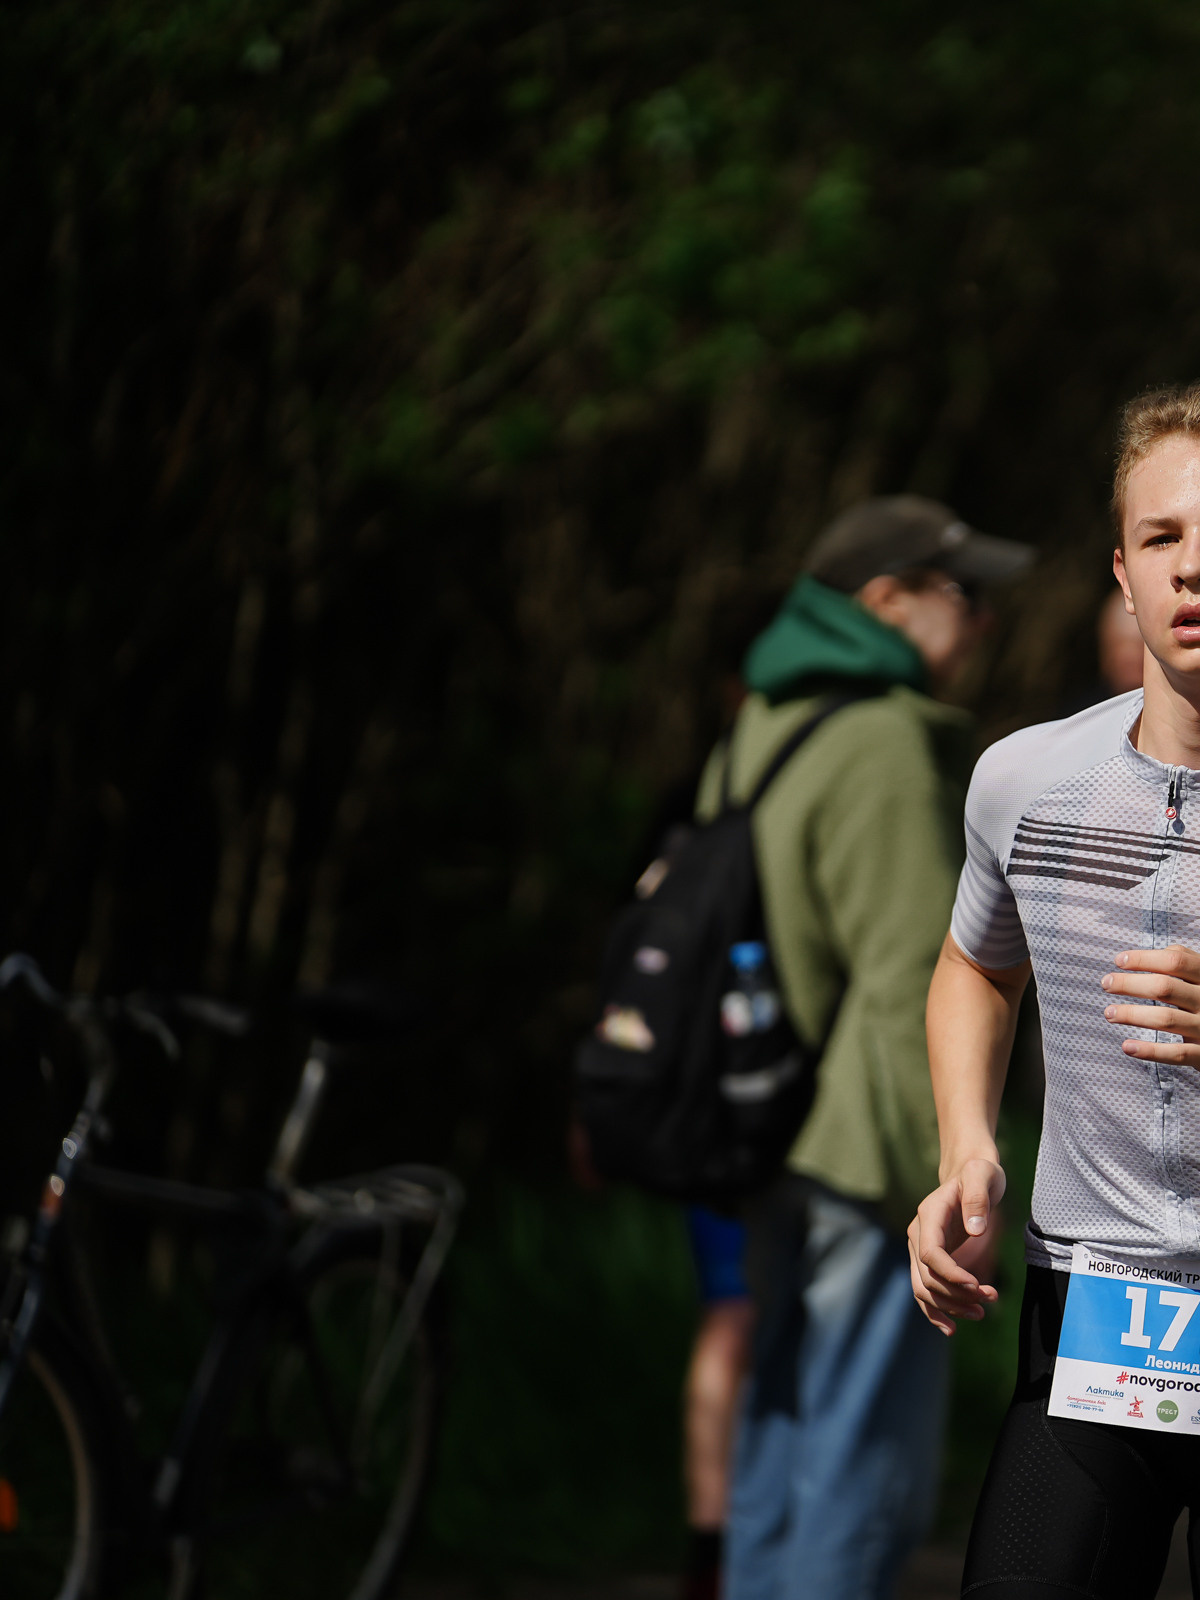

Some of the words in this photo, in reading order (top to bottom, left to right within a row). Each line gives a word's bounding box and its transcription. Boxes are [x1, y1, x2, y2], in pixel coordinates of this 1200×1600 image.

[1088, 1260, 1182, 1283] НОВГОРОДСКИЙ
[1144, 1354, 1200, 1374] Леонид
[1157, 1407, 1178, 1415] ТРЕСТ
